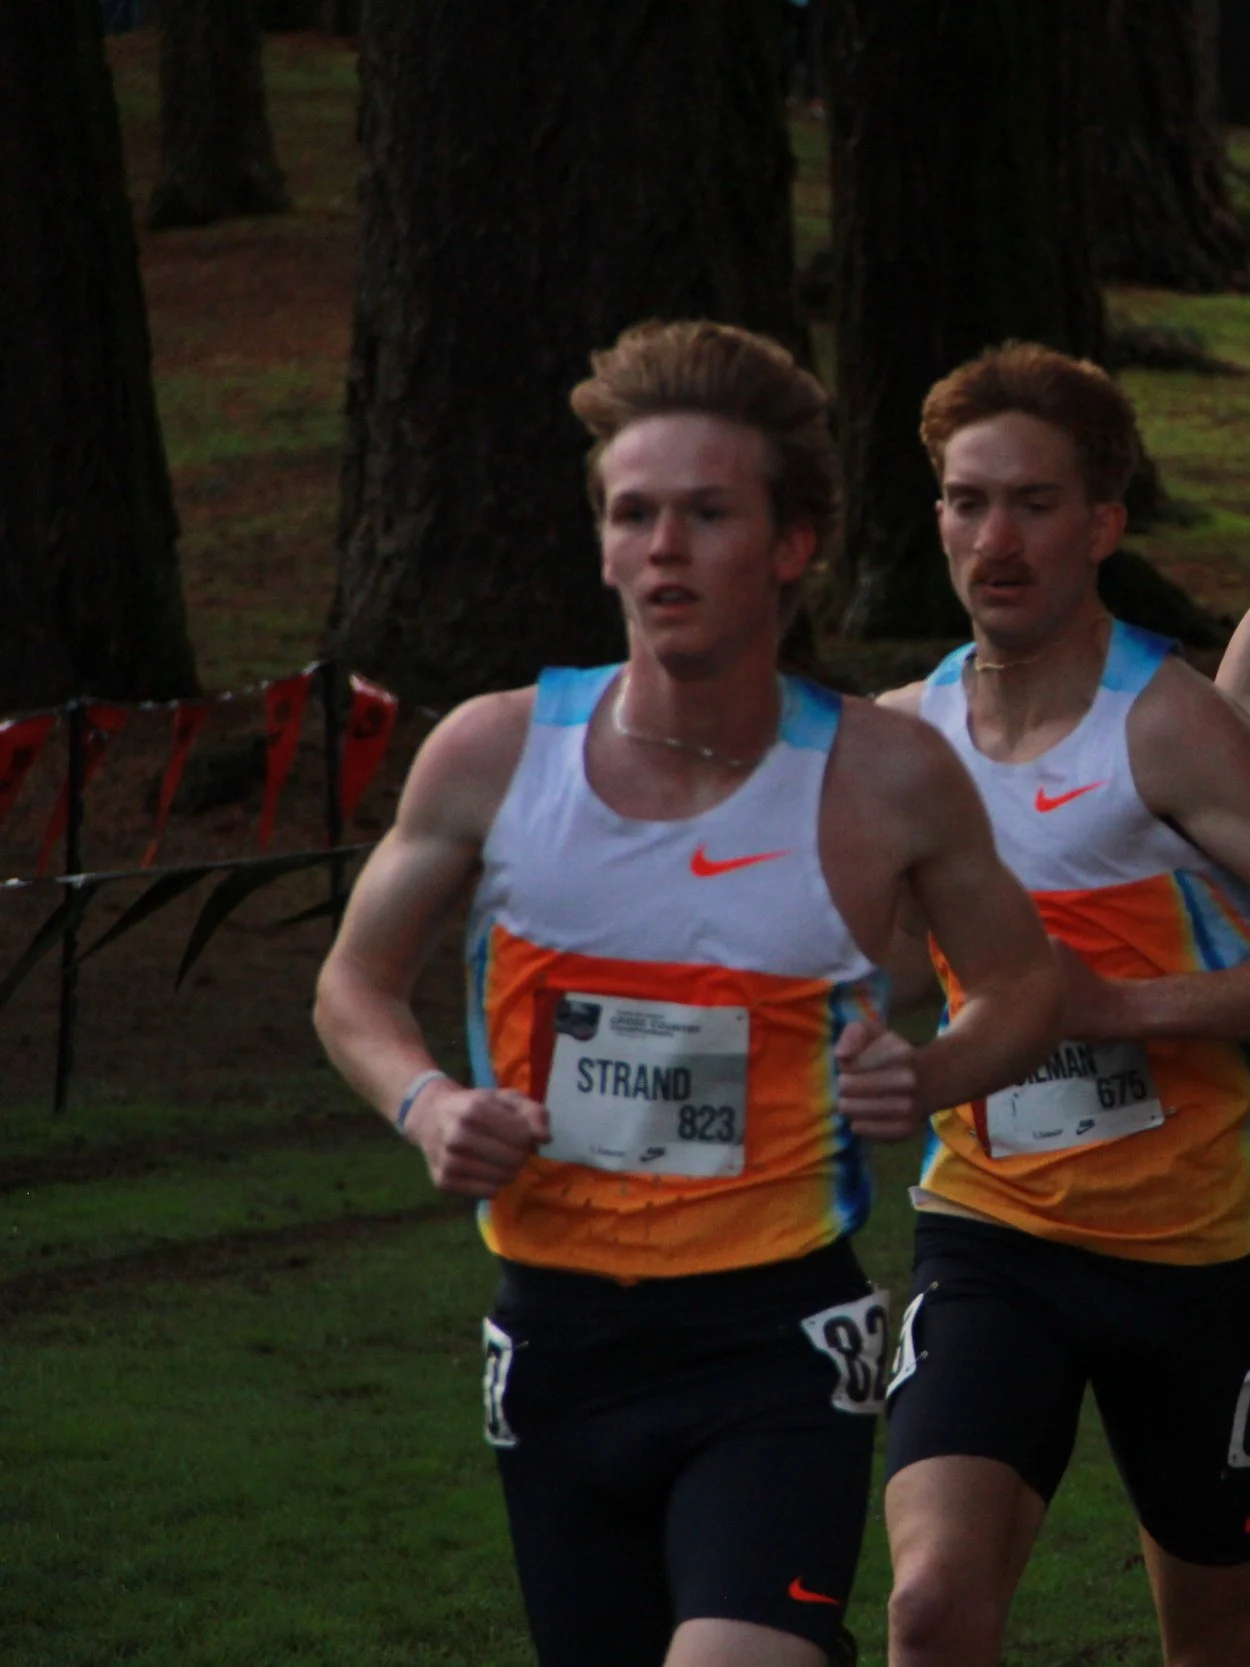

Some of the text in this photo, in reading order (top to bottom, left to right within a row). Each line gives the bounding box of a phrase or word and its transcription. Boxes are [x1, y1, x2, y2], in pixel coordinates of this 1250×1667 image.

[576, 1056, 692, 1101] STRAND
[1096, 1069, 1148, 1110] 675
[677, 1104, 736, 1143] 823
